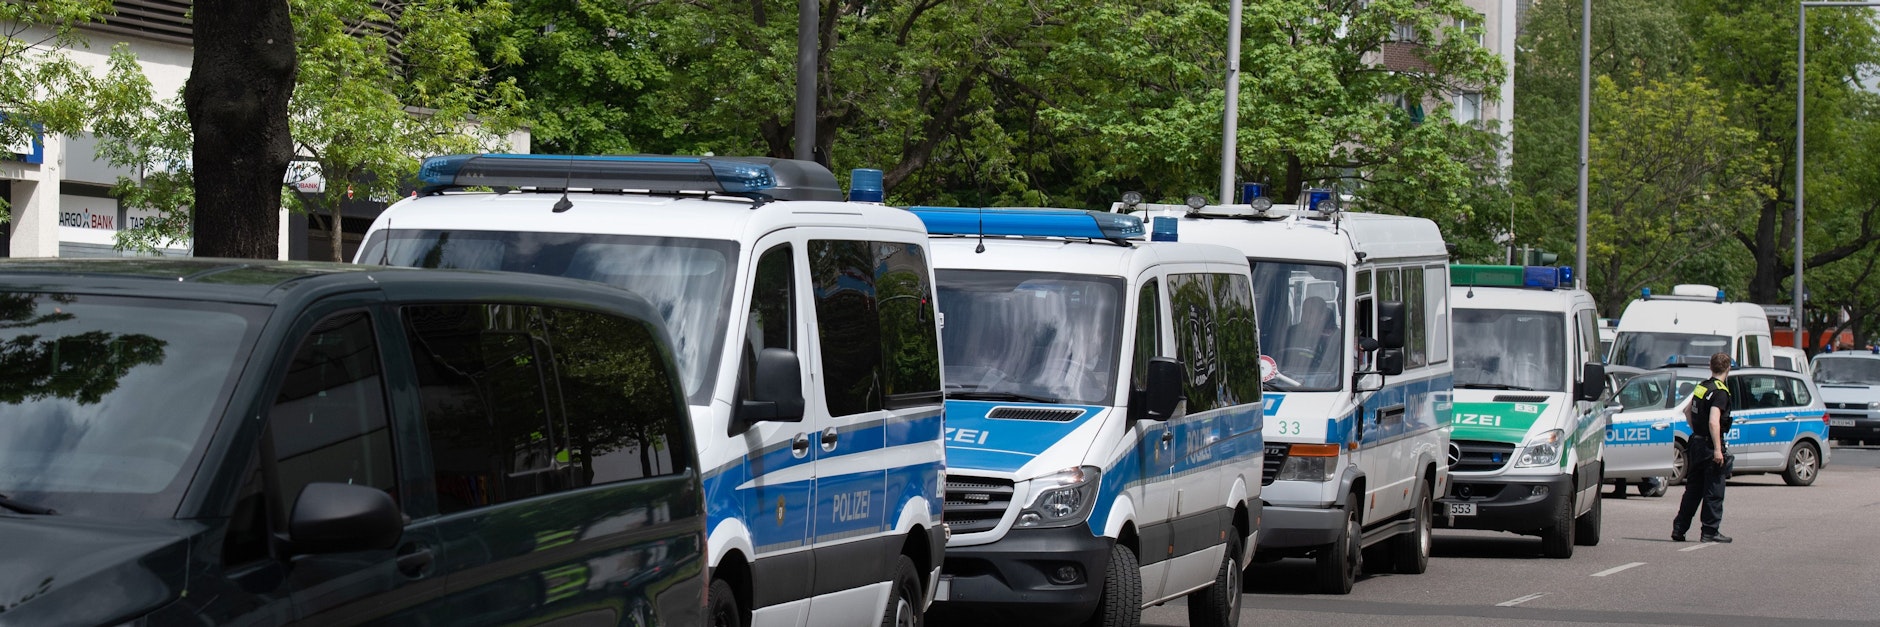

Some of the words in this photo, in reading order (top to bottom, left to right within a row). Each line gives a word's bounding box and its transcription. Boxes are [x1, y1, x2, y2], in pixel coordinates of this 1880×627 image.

[59, 211, 82, 228] ARGO
[91, 213, 114, 230] BANK
[1452, 413, 1501, 427] IZEI
[1605, 427, 1651, 442] OLIZEI
[832, 489, 871, 524] POLIZEI
[1451, 503, 1471, 514] 553
